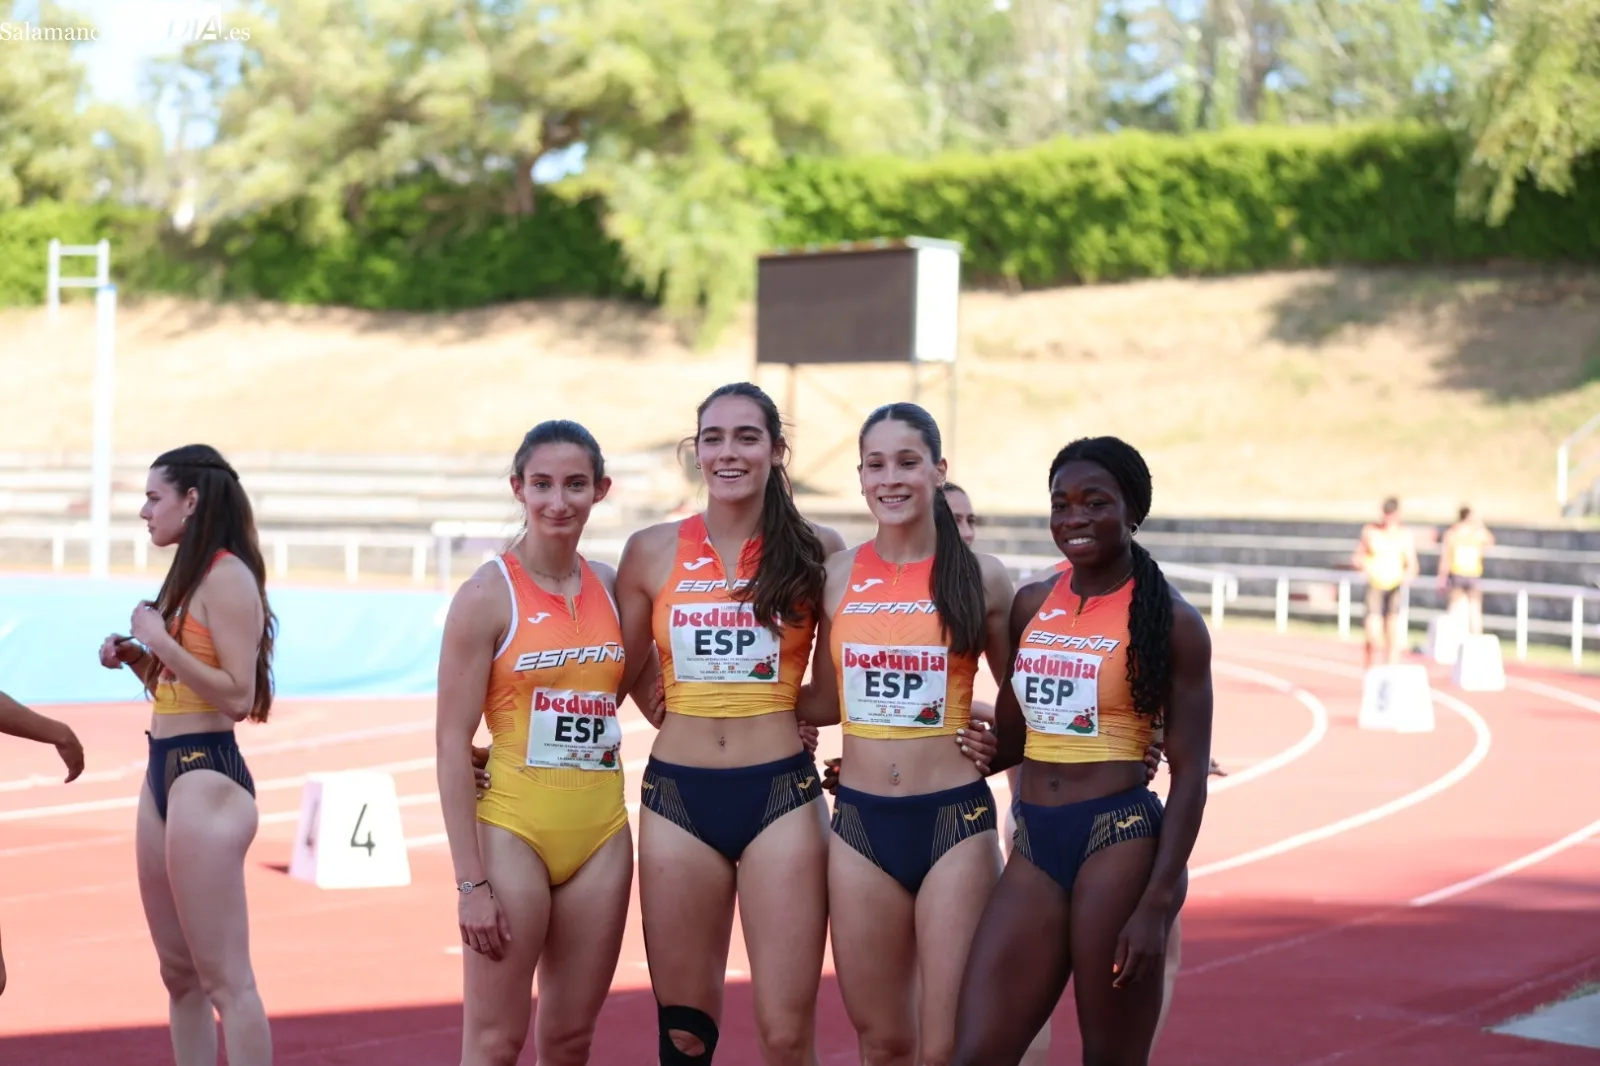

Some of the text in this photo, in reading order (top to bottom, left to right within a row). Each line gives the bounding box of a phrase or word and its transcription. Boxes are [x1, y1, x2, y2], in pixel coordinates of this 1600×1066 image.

[673, 608, 778, 628] bedun
[695, 629, 756, 656] ESP
[1025, 630, 1120, 652] ESPAÑA
[844, 648, 945, 672] bedunia
[1015, 653, 1097, 680] bedunia
[865, 671, 923, 699] ESP
[1025, 676, 1074, 706] ESP
[534, 692, 616, 717] bedunia
[554, 716, 605, 743] ESP
[350, 803, 376, 857] 4
